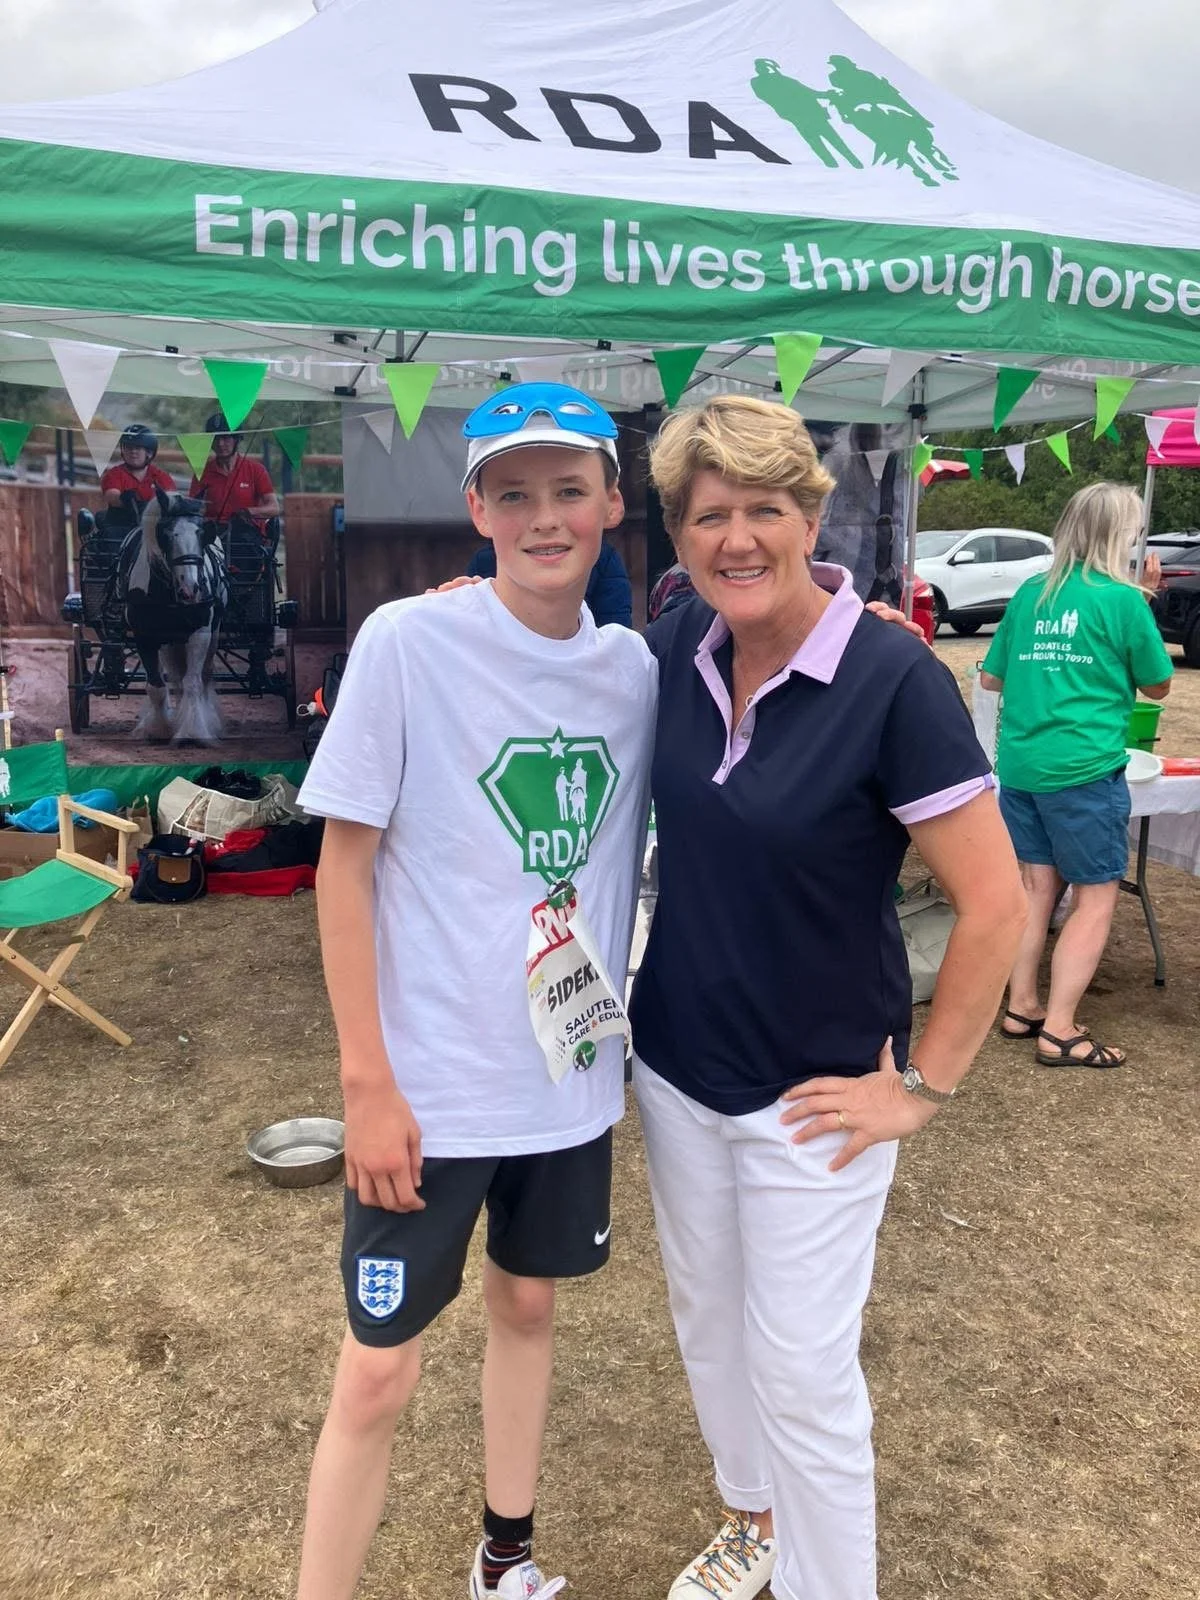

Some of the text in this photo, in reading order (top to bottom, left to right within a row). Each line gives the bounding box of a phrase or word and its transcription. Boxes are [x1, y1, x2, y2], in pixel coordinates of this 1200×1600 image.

[408, 73, 792, 165] RDA
[195, 194, 577, 297] Enriching
[602, 219, 766, 292] lives
[781, 240, 1033, 315] through
[1034, 620, 1060, 635] RDA
[1065, 654, 1093, 664] 70970
[528, 826, 589, 868] RDA
[547, 962, 601, 1014] SIDEK
[568, 1023, 591, 1045] CARE
